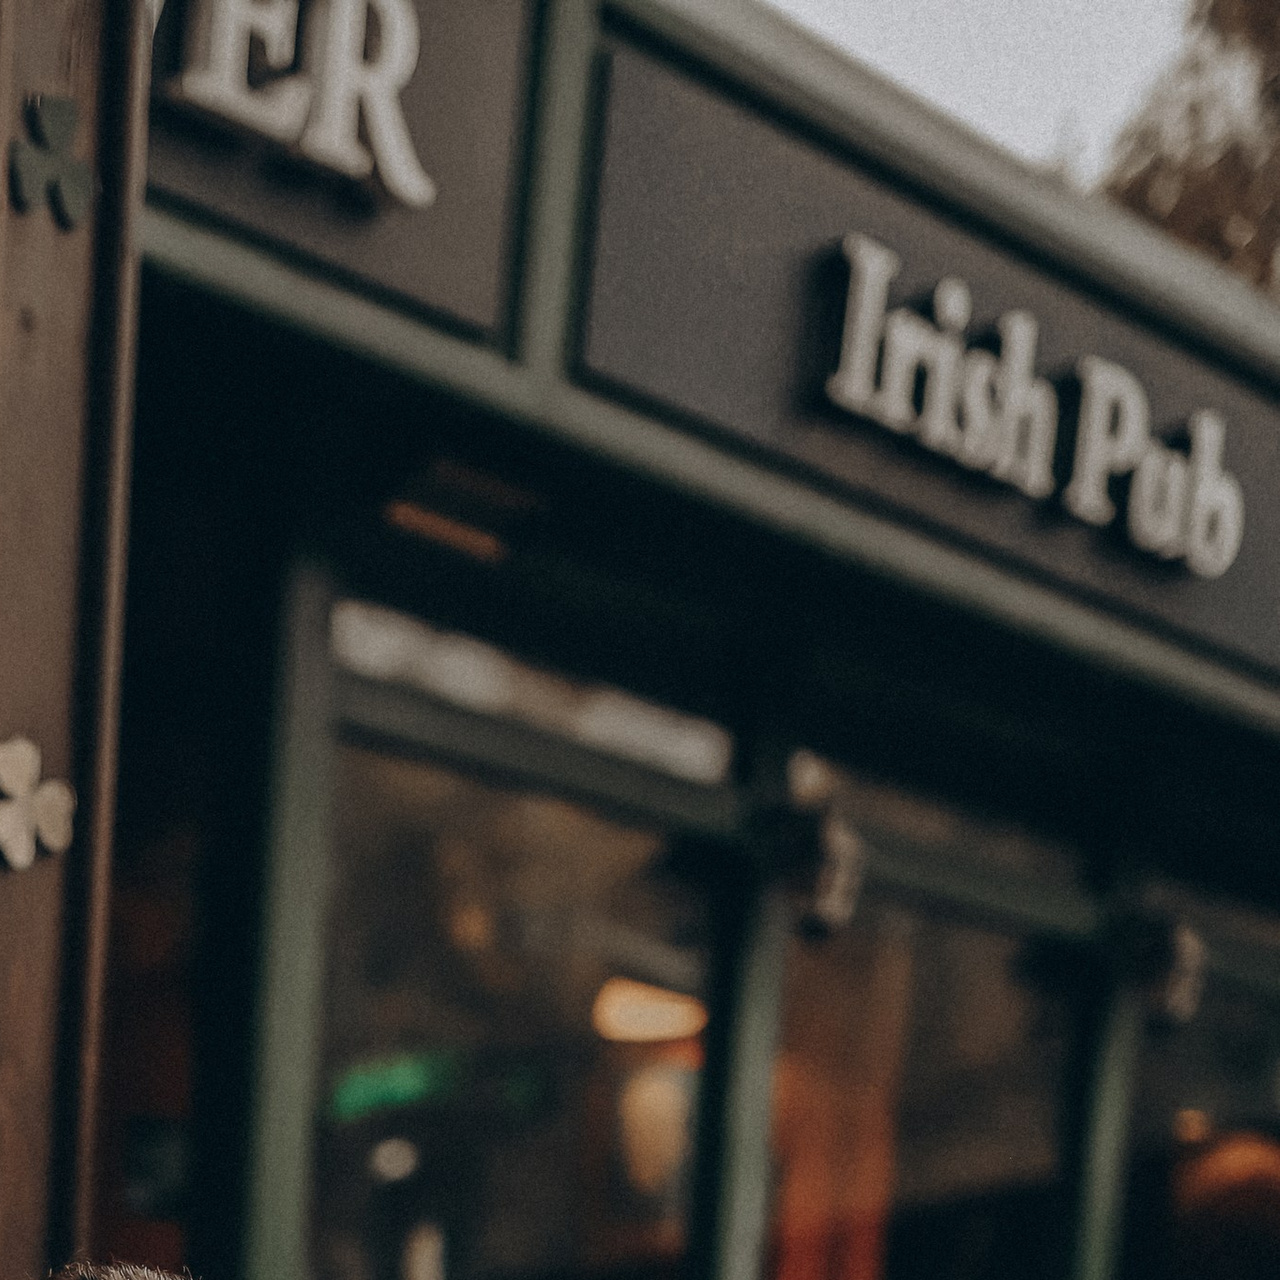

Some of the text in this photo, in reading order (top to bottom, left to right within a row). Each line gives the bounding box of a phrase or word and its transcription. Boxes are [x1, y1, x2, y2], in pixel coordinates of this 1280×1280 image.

[152, 0, 438, 208] ER
[825, 232, 1246, 580] Irish Pub
